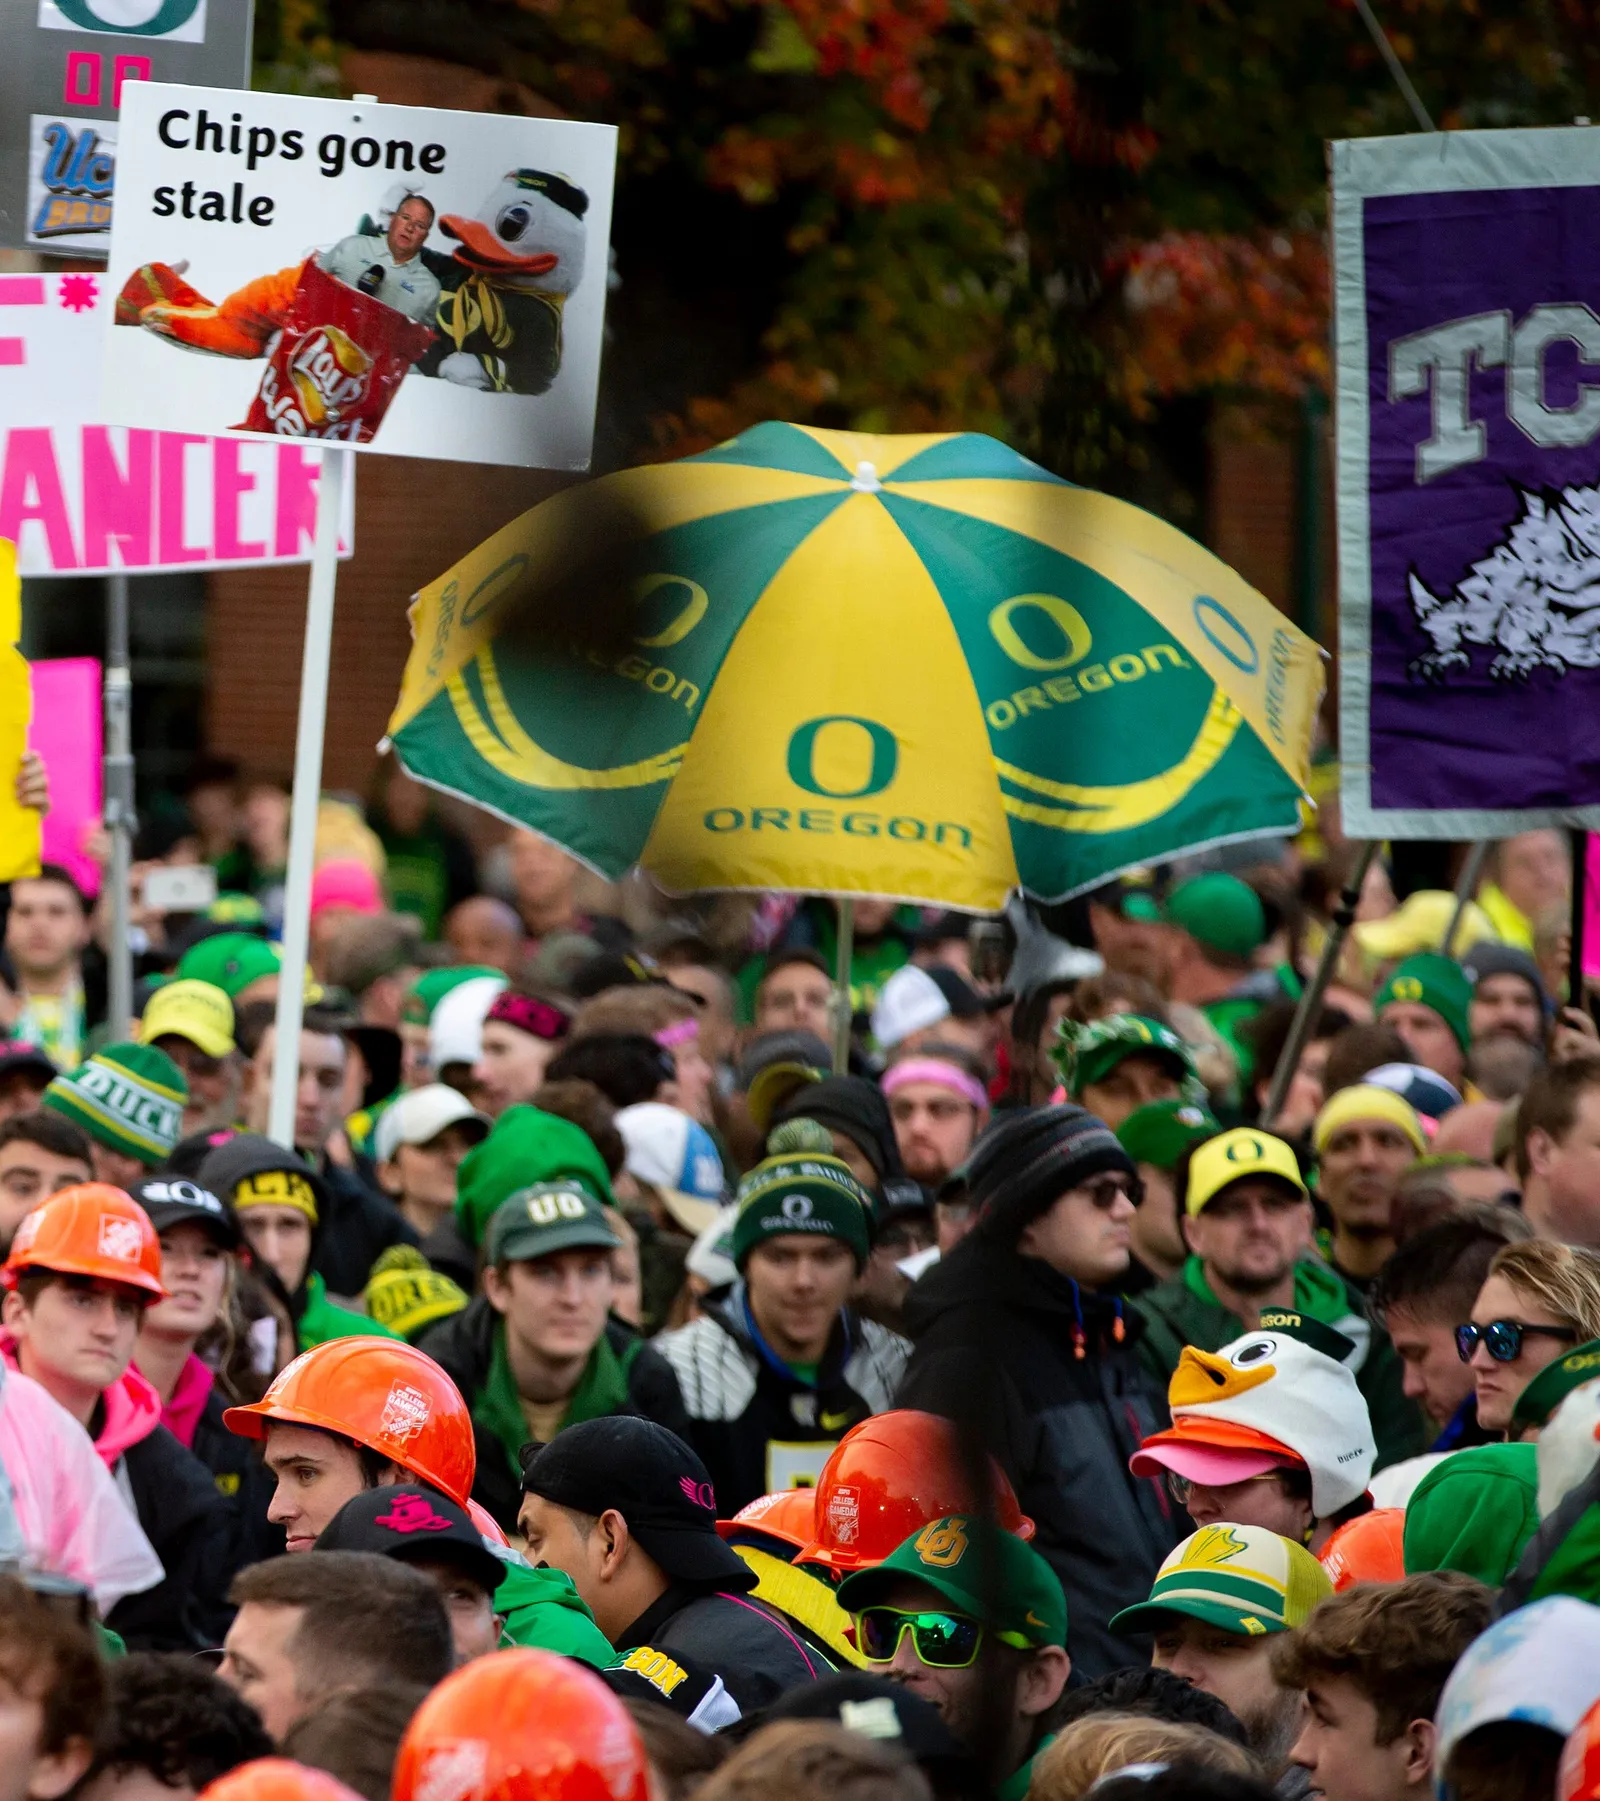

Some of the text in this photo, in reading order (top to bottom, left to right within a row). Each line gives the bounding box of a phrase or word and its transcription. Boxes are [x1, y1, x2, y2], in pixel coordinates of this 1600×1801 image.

[158, 108, 447, 178] Chips gone
[151, 181, 275, 227] stale
[985, 643, 1192, 731] OREGON
[703, 806, 977, 851] OREGON
[387, 1393, 430, 1421] GAMEDAY
[395, 1388, 428, 1411] COLLEGE
[829, 1504, 858, 1518] GAMEDAY
[832, 1496, 856, 1507] COLLEGE
